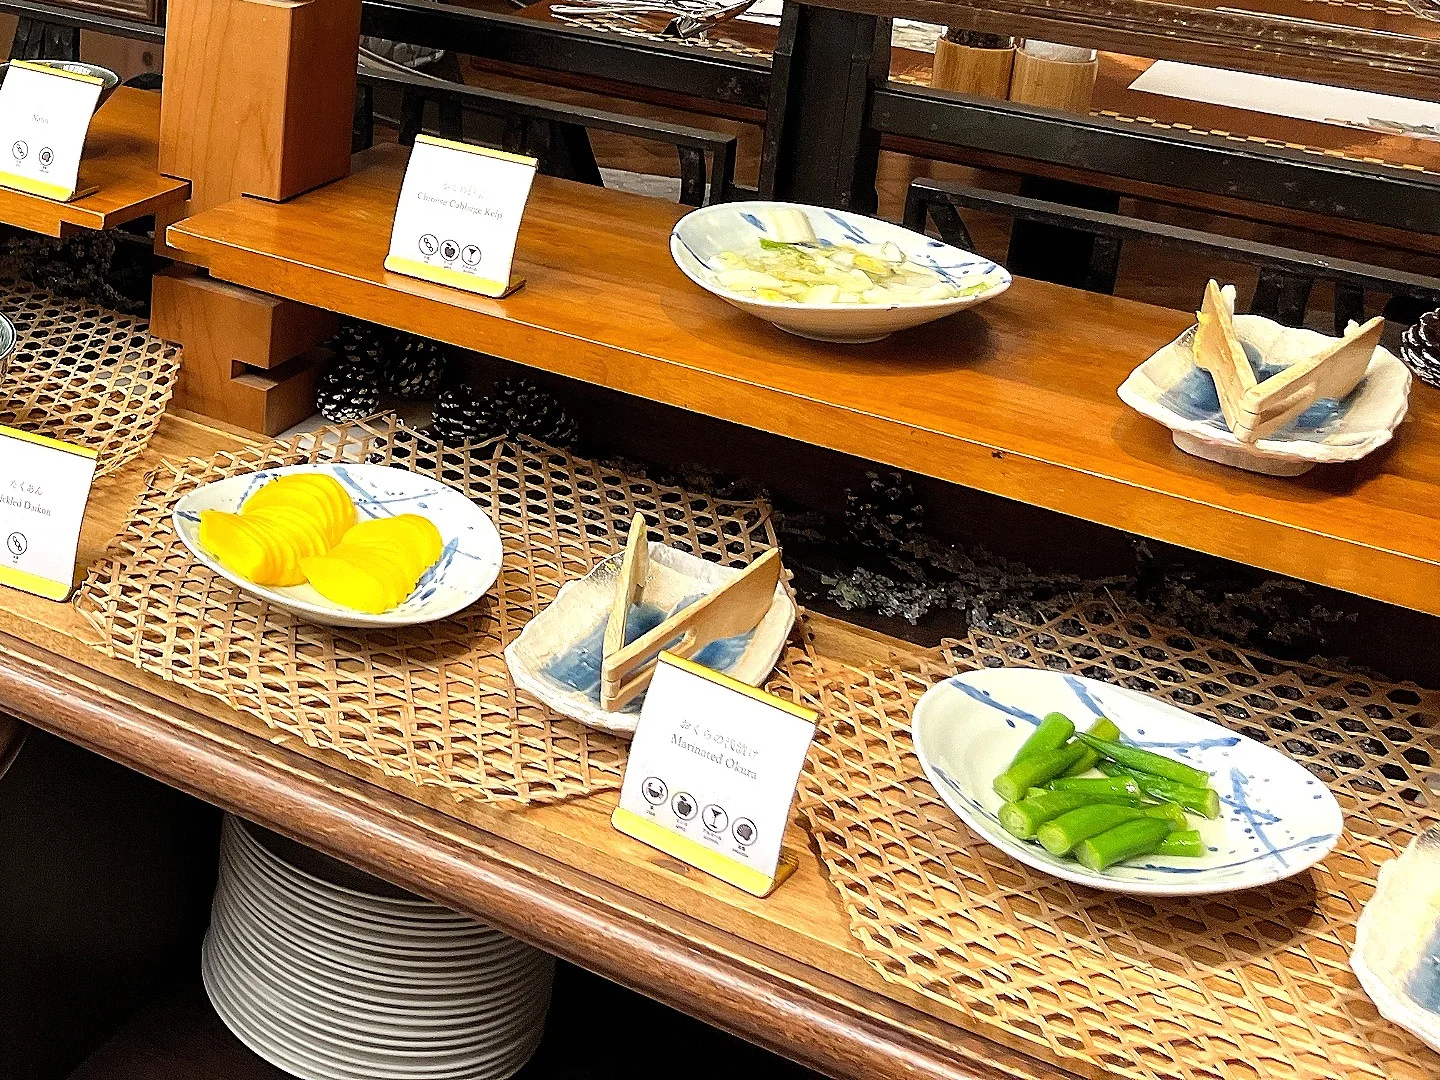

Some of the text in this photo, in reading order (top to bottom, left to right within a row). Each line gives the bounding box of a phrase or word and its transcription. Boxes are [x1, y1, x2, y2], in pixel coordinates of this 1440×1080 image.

[417, 191, 447, 206] Chinese
[449, 199, 482, 215] Cabbage
[484, 207, 503, 220] Kelp
[23, 500, 51, 517] Daikon
[670, 733, 758, 780] Marinated Okura
